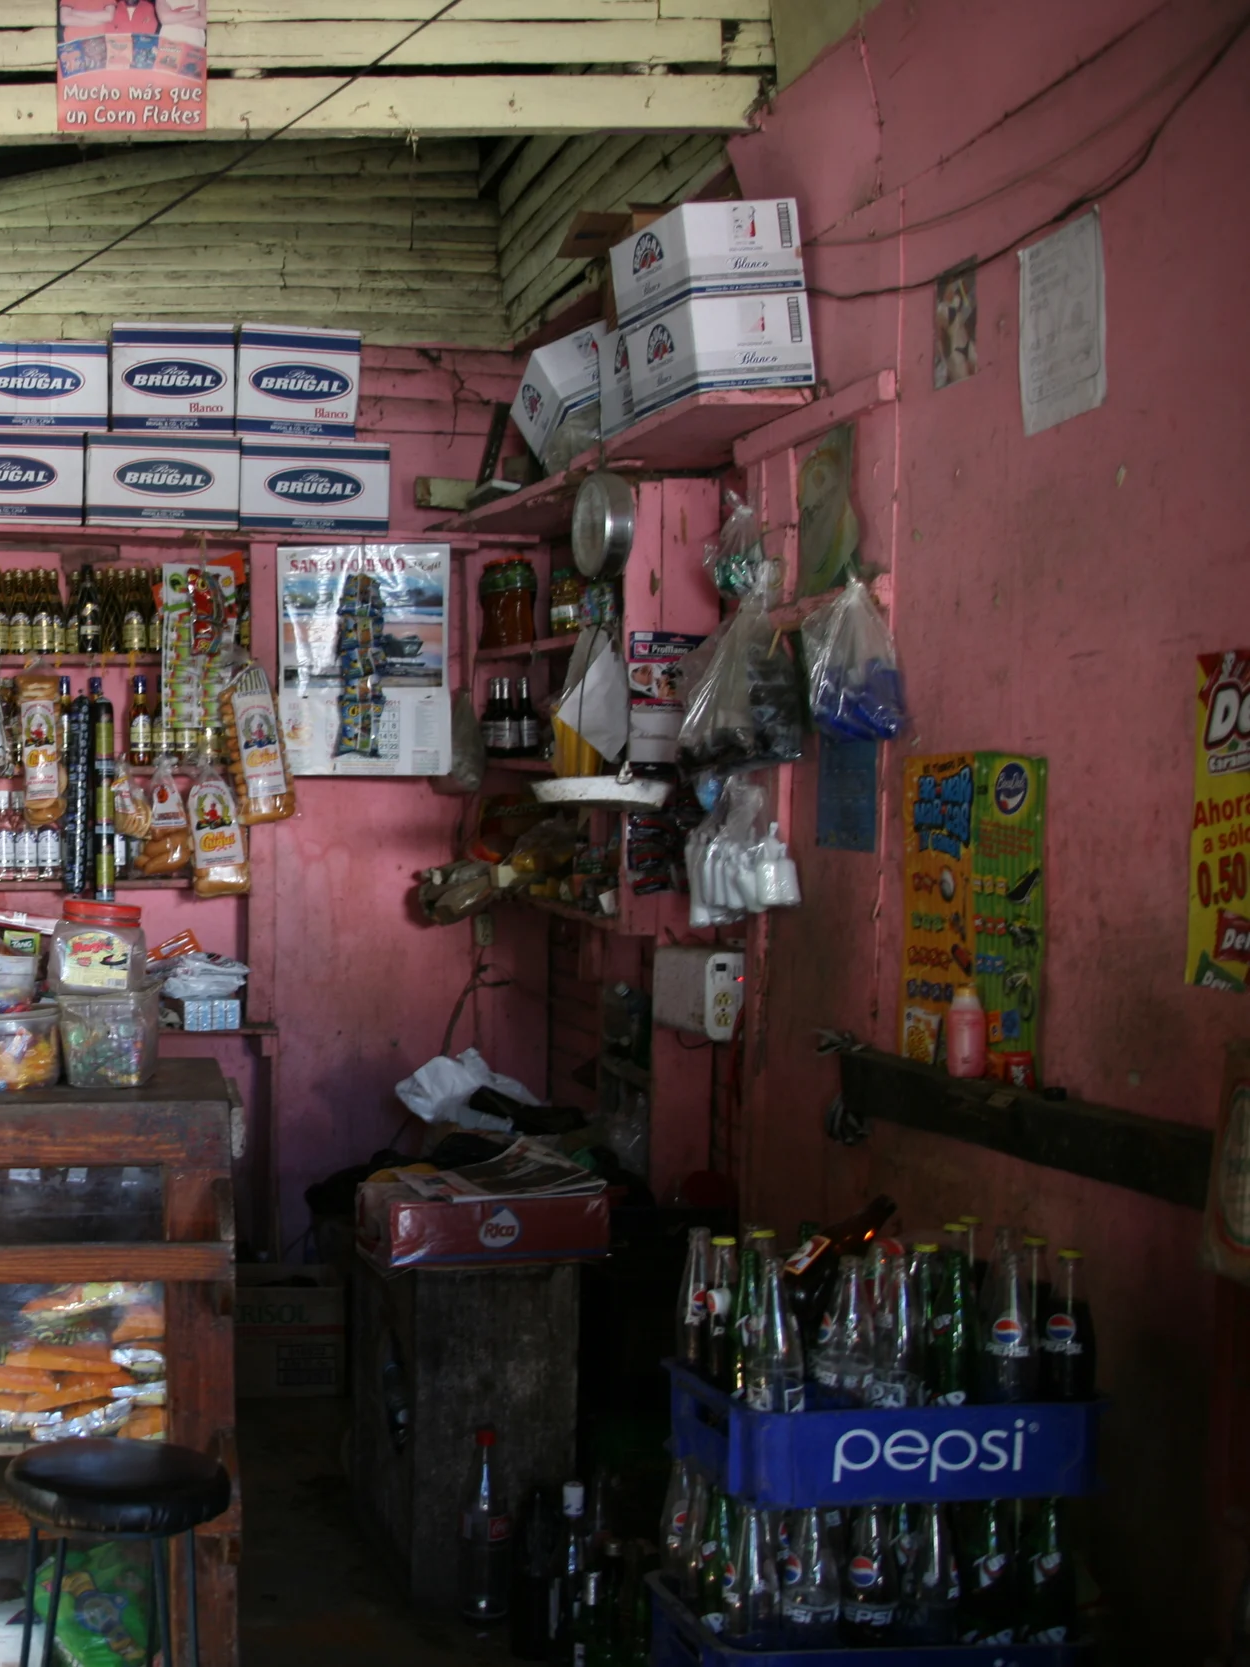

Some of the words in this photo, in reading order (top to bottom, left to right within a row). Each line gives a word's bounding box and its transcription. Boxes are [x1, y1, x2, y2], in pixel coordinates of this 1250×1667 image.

[63, 83, 121, 102] Mucho
[128, 83, 162, 101] más
[169, 88, 203, 104] que
[66, 109, 87, 125] un
[94, 106, 136, 125] Corn
[143, 105, 201, 125] Flakes
[132, 374, 216, 387] BRUGAL
[260, 377, 343, 393] BRUGAL
[189, 402, 223, 413] Blanco
[314, 407, 348, 419] Blanco
[123, 472, 206, 487] BRUGAL
[275, 481, 356, 496] BRUGAL
[290, 559, 336, 573] SANO
[1203, 837, 1213, 854] a
[1197, 852, 1247, 909] 0.50
[11, 940, 32, 949] TANG
[482, 1223, 517, 1238] Rica
[832, 1418, 1025, 1483] pepsi
